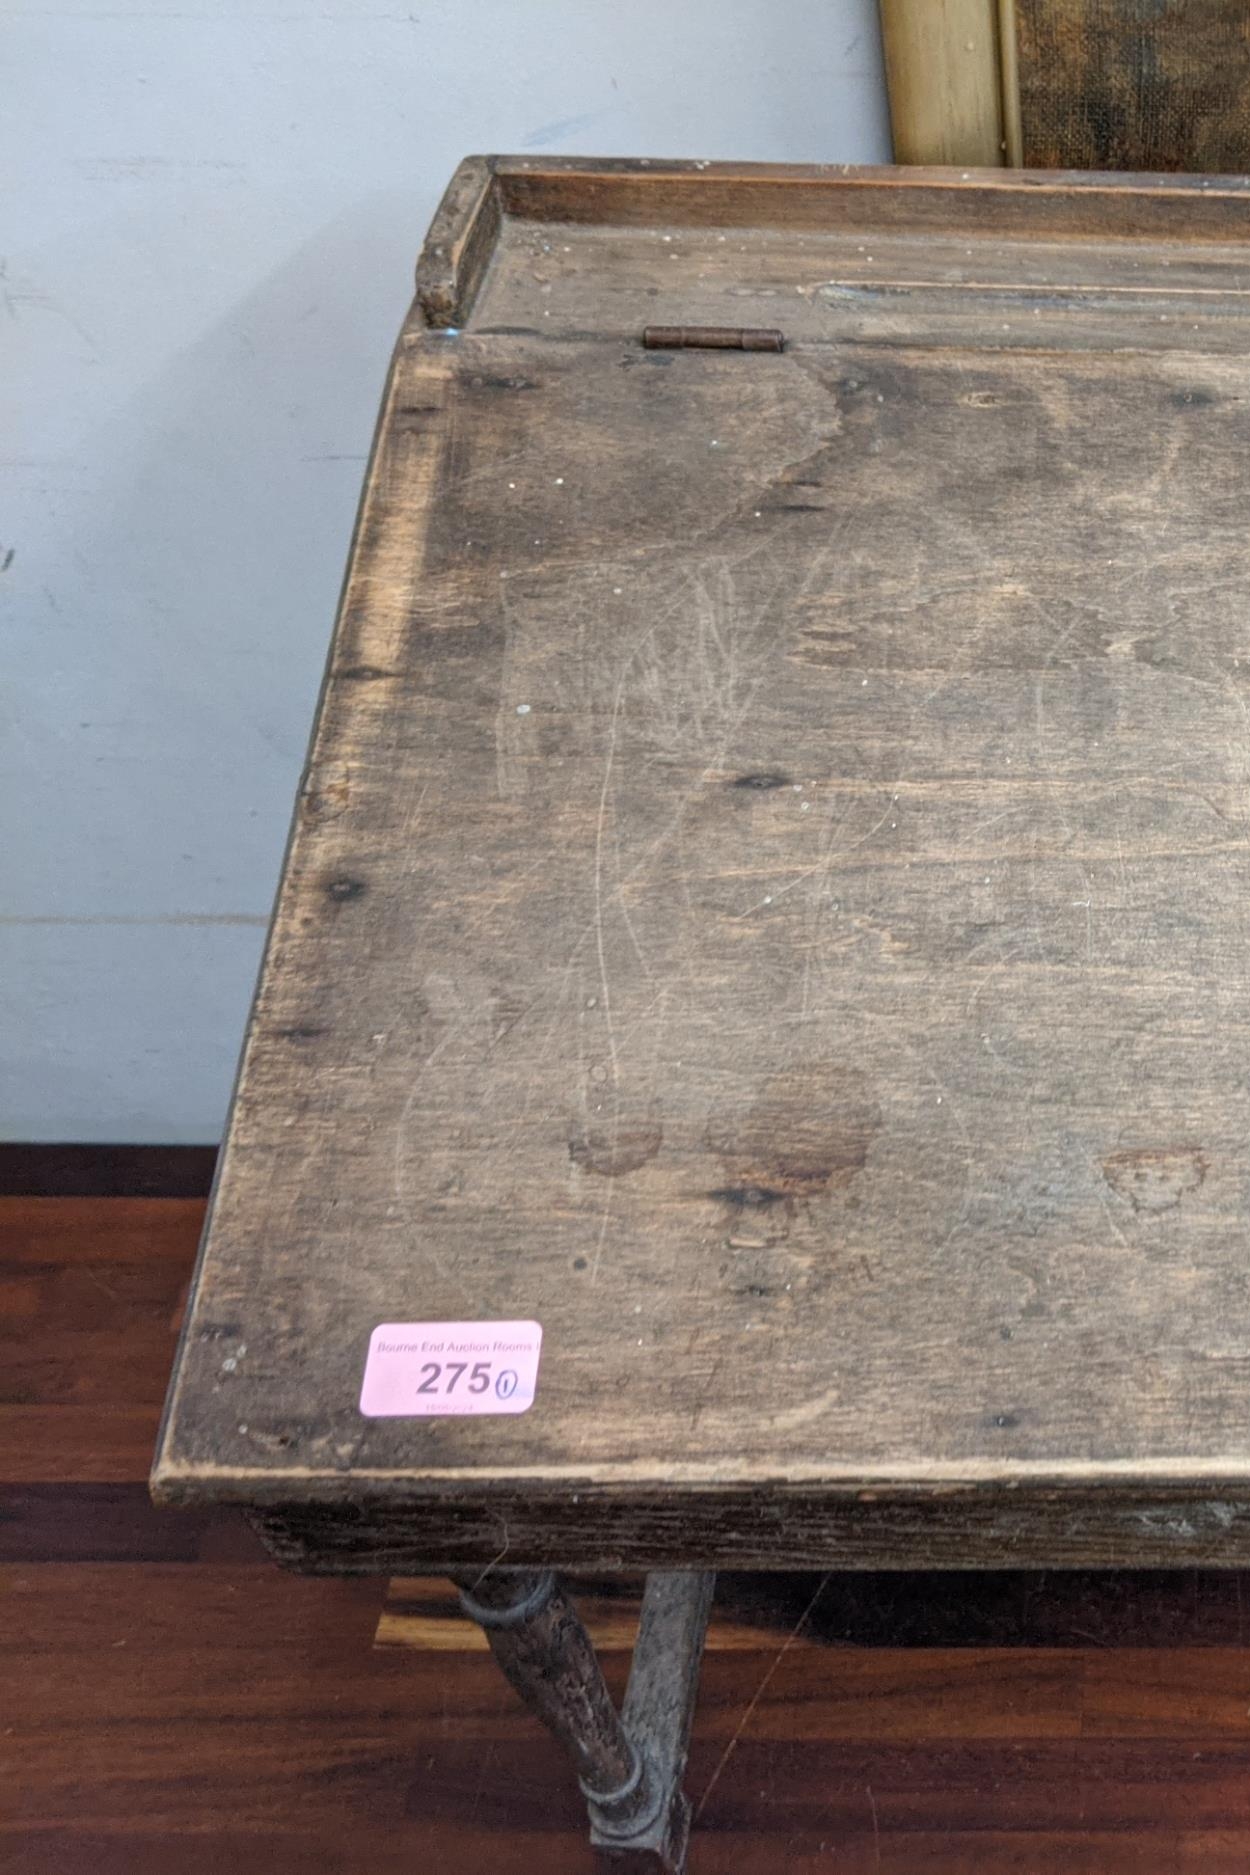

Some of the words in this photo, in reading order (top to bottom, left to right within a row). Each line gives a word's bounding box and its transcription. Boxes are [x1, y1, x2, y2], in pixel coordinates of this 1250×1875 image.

[377, 1341, 418, 1353] Bourne
[421, 1341, 445, 1352] End
[447, 1341, 490, 1352] Auction
[492, 1341, 533, 1352] Rooms
[416, 1362, 492, 1394] 275
